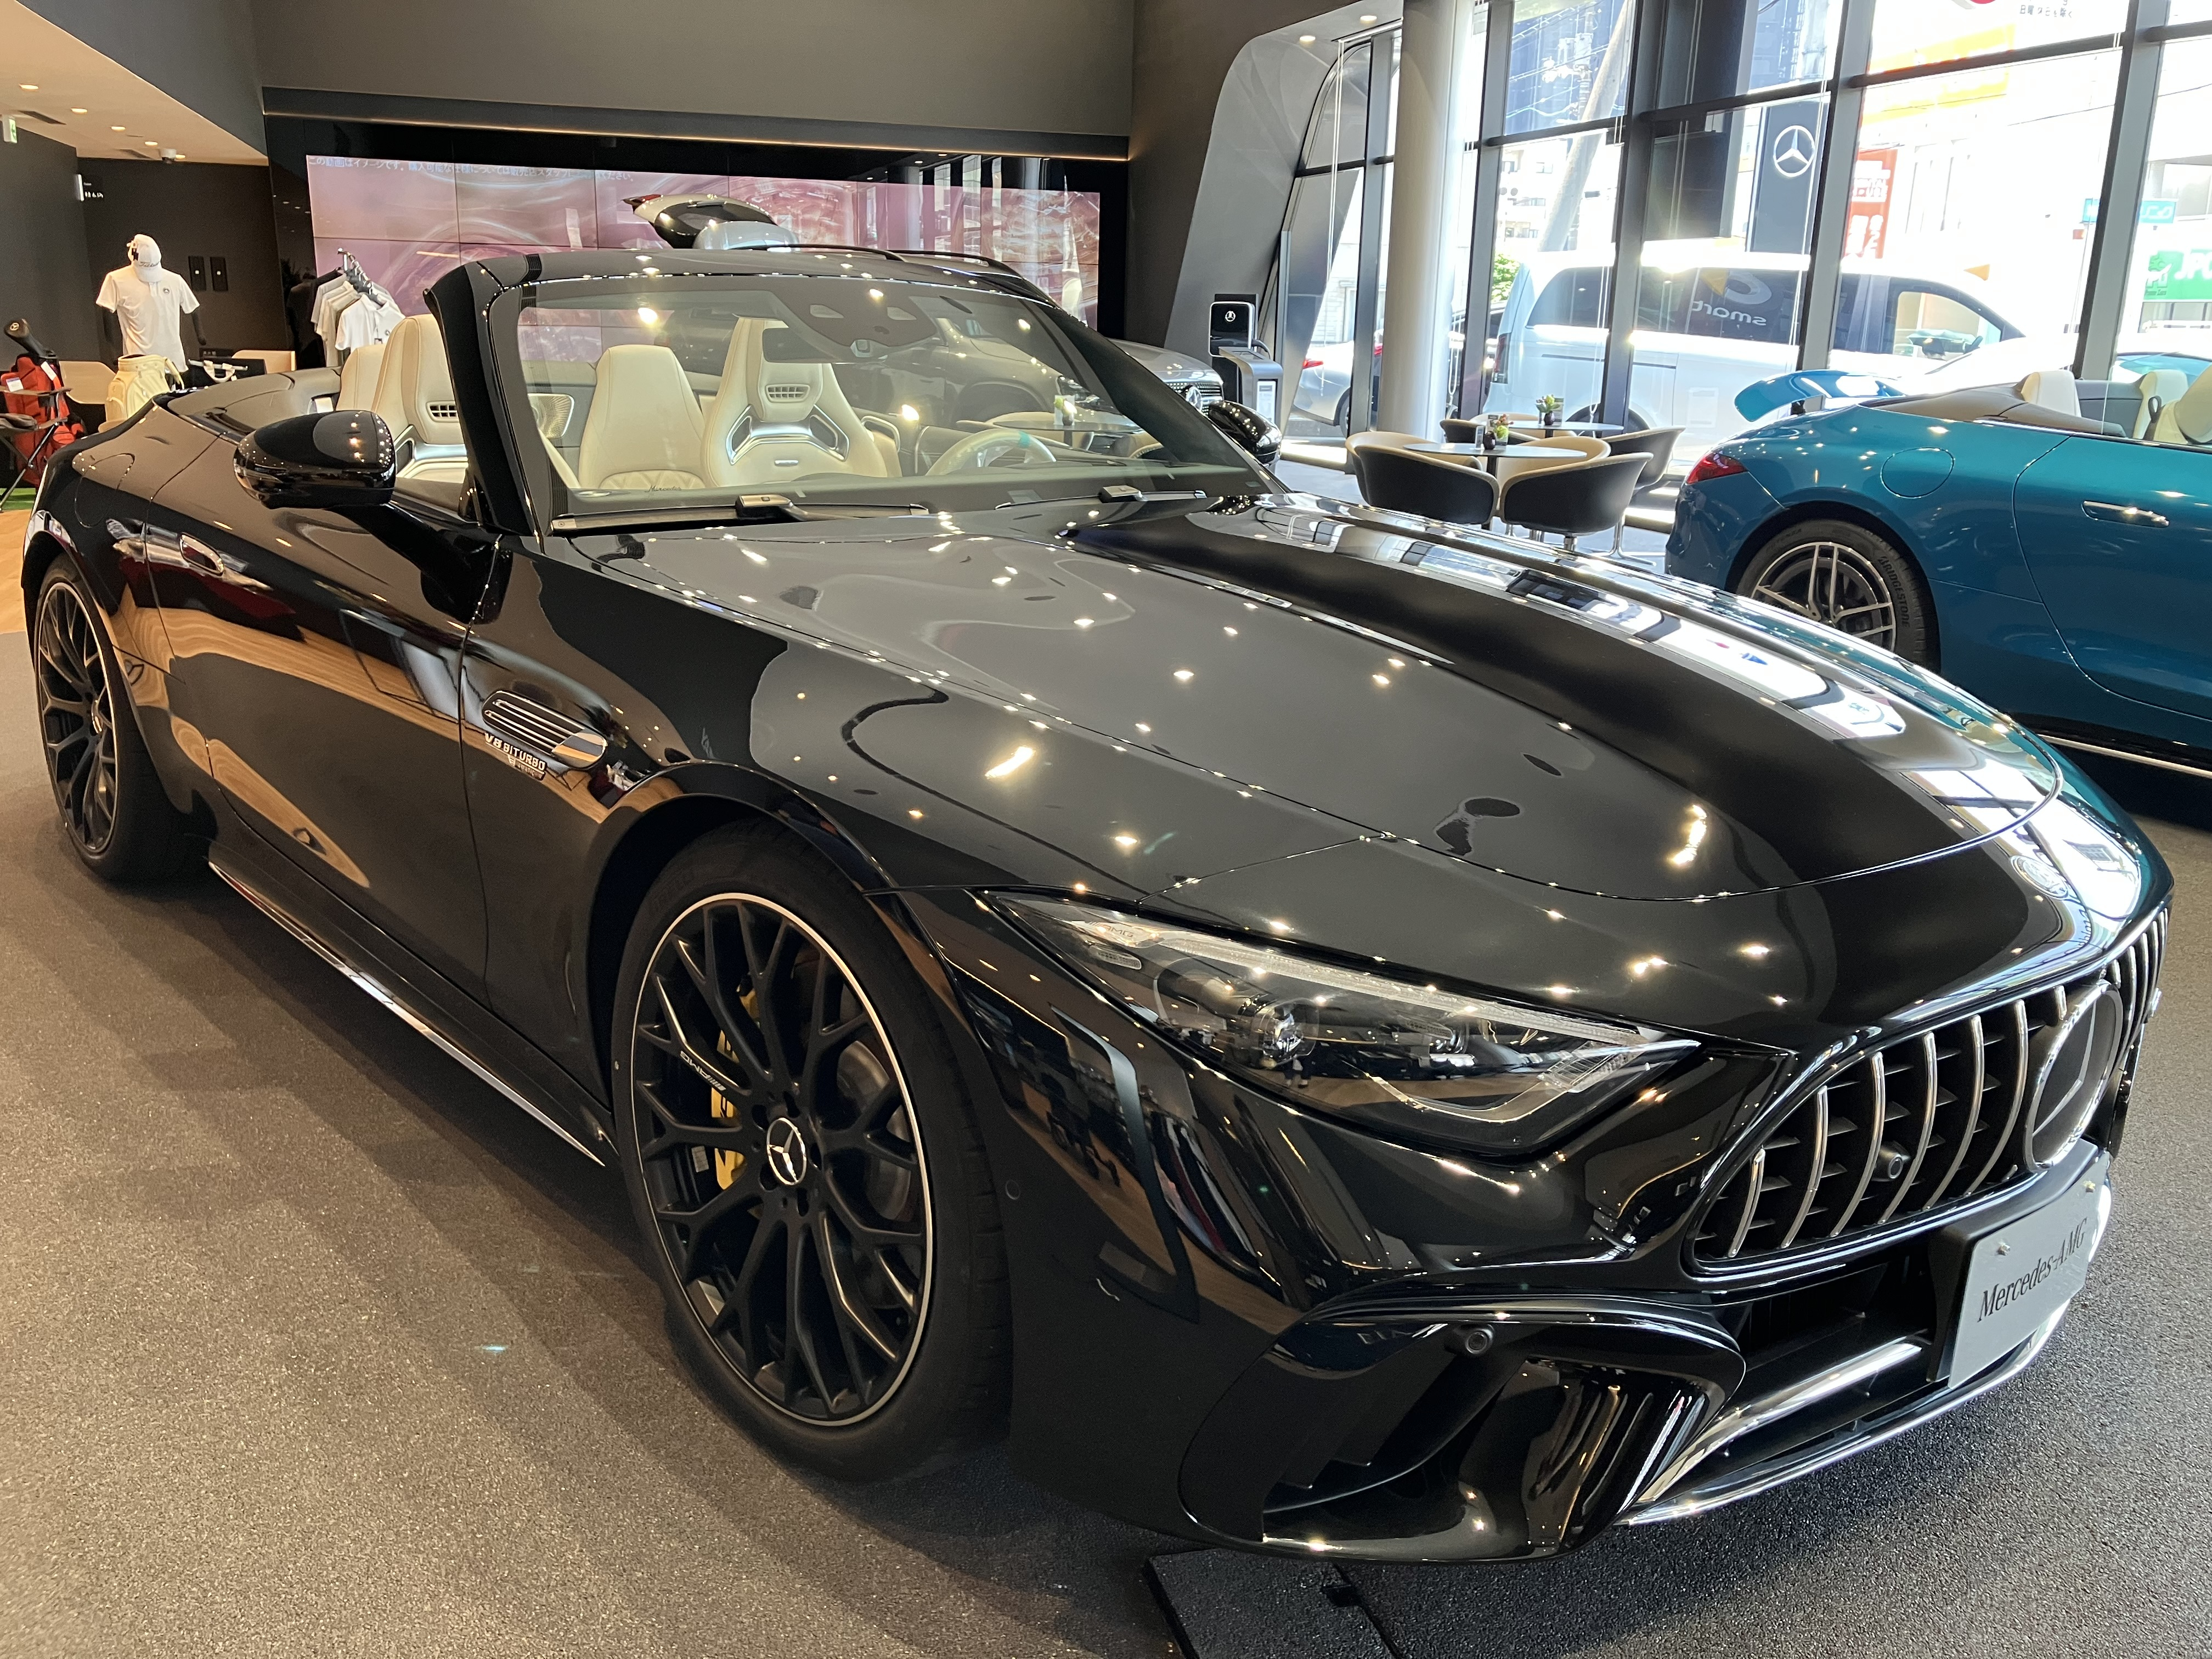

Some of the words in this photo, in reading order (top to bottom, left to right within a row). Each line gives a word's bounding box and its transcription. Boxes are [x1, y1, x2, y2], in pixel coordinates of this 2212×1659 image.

[1878, 556, 1910, 628] BRIDGESTONE
[484, 732, 503, 749] V8
[503, 742, 546, 771] BITURBO
[1096, 923, 1135, 938] AMG
[1977, 1216, 2088, 1323] Mercedes-AMG
